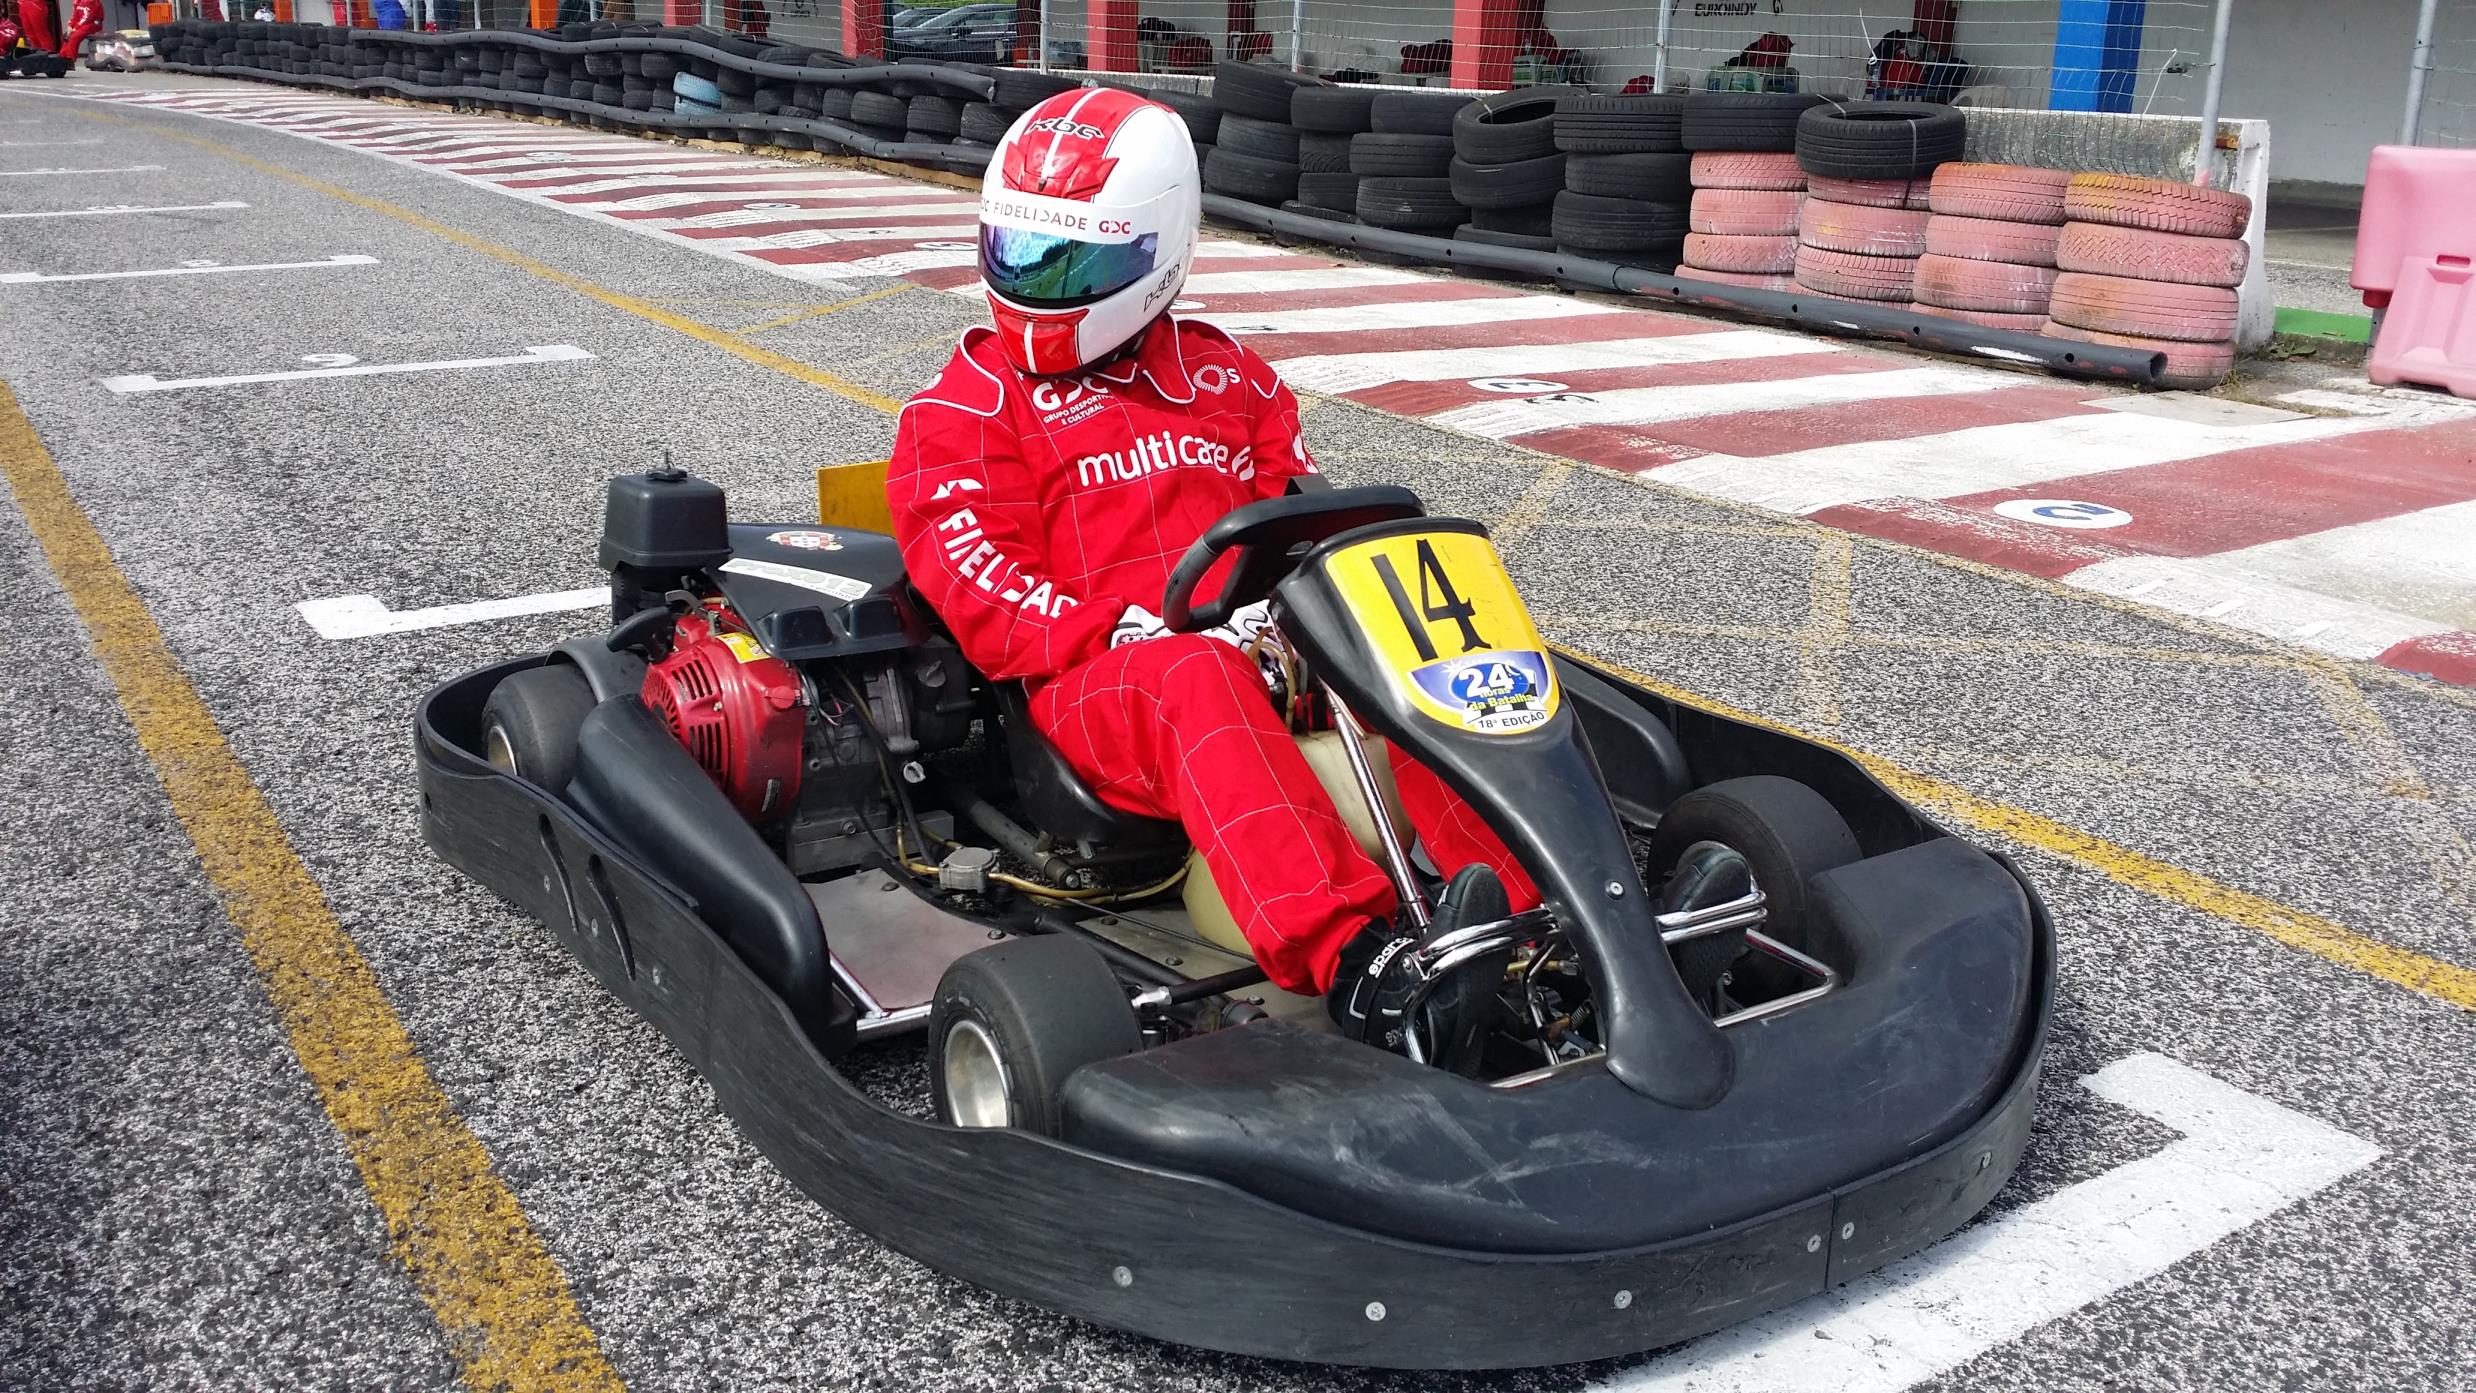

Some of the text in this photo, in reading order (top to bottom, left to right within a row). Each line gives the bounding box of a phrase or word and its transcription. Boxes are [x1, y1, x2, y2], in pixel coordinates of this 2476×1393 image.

[993, 202, 1088, 231] FIDELIDADE
[1043, 408, 1070, 424] GRUPO
[1067, 402, 1105, 424] CULTURAL
[1370, 538, 1492, 662] 14
[1458, 663, 1515, 698] 24
[1470, 692, 1534, 711] da Batalha
[1502, 711, 1545, 727] EDIÇÃO
